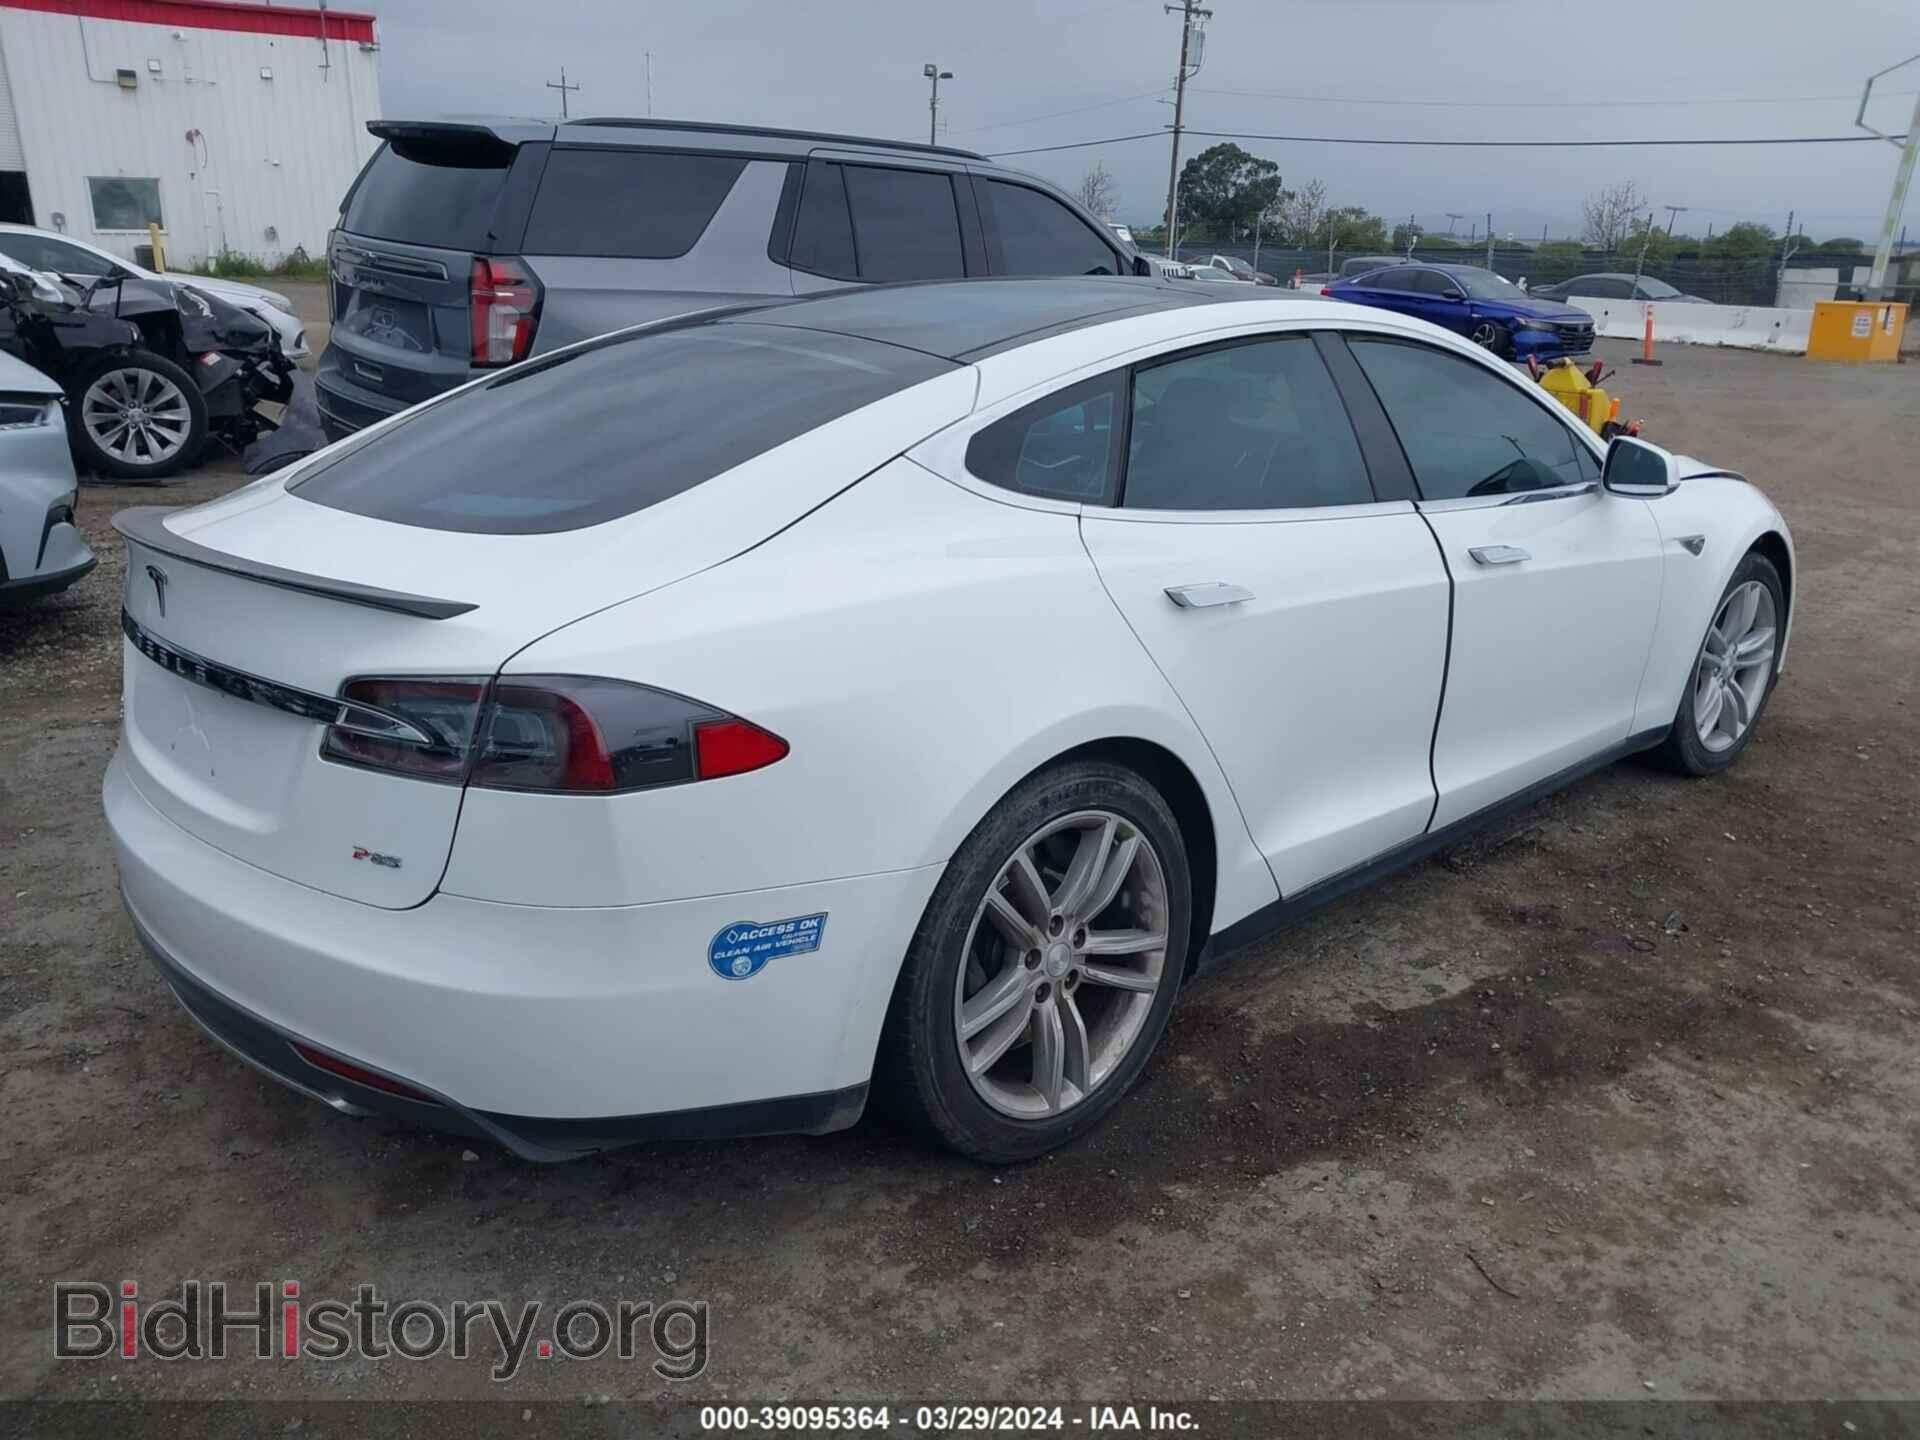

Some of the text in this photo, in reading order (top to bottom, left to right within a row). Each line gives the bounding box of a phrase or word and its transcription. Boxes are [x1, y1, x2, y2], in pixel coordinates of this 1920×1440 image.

[738, 922, 795, 941] ACCESS
[800, 918, 819, 930] OK
[714, 942, 750, 959] CLEAN
[753, 944, 772, 952] AIR
[775, 934, 817, 947] VEHICLE
